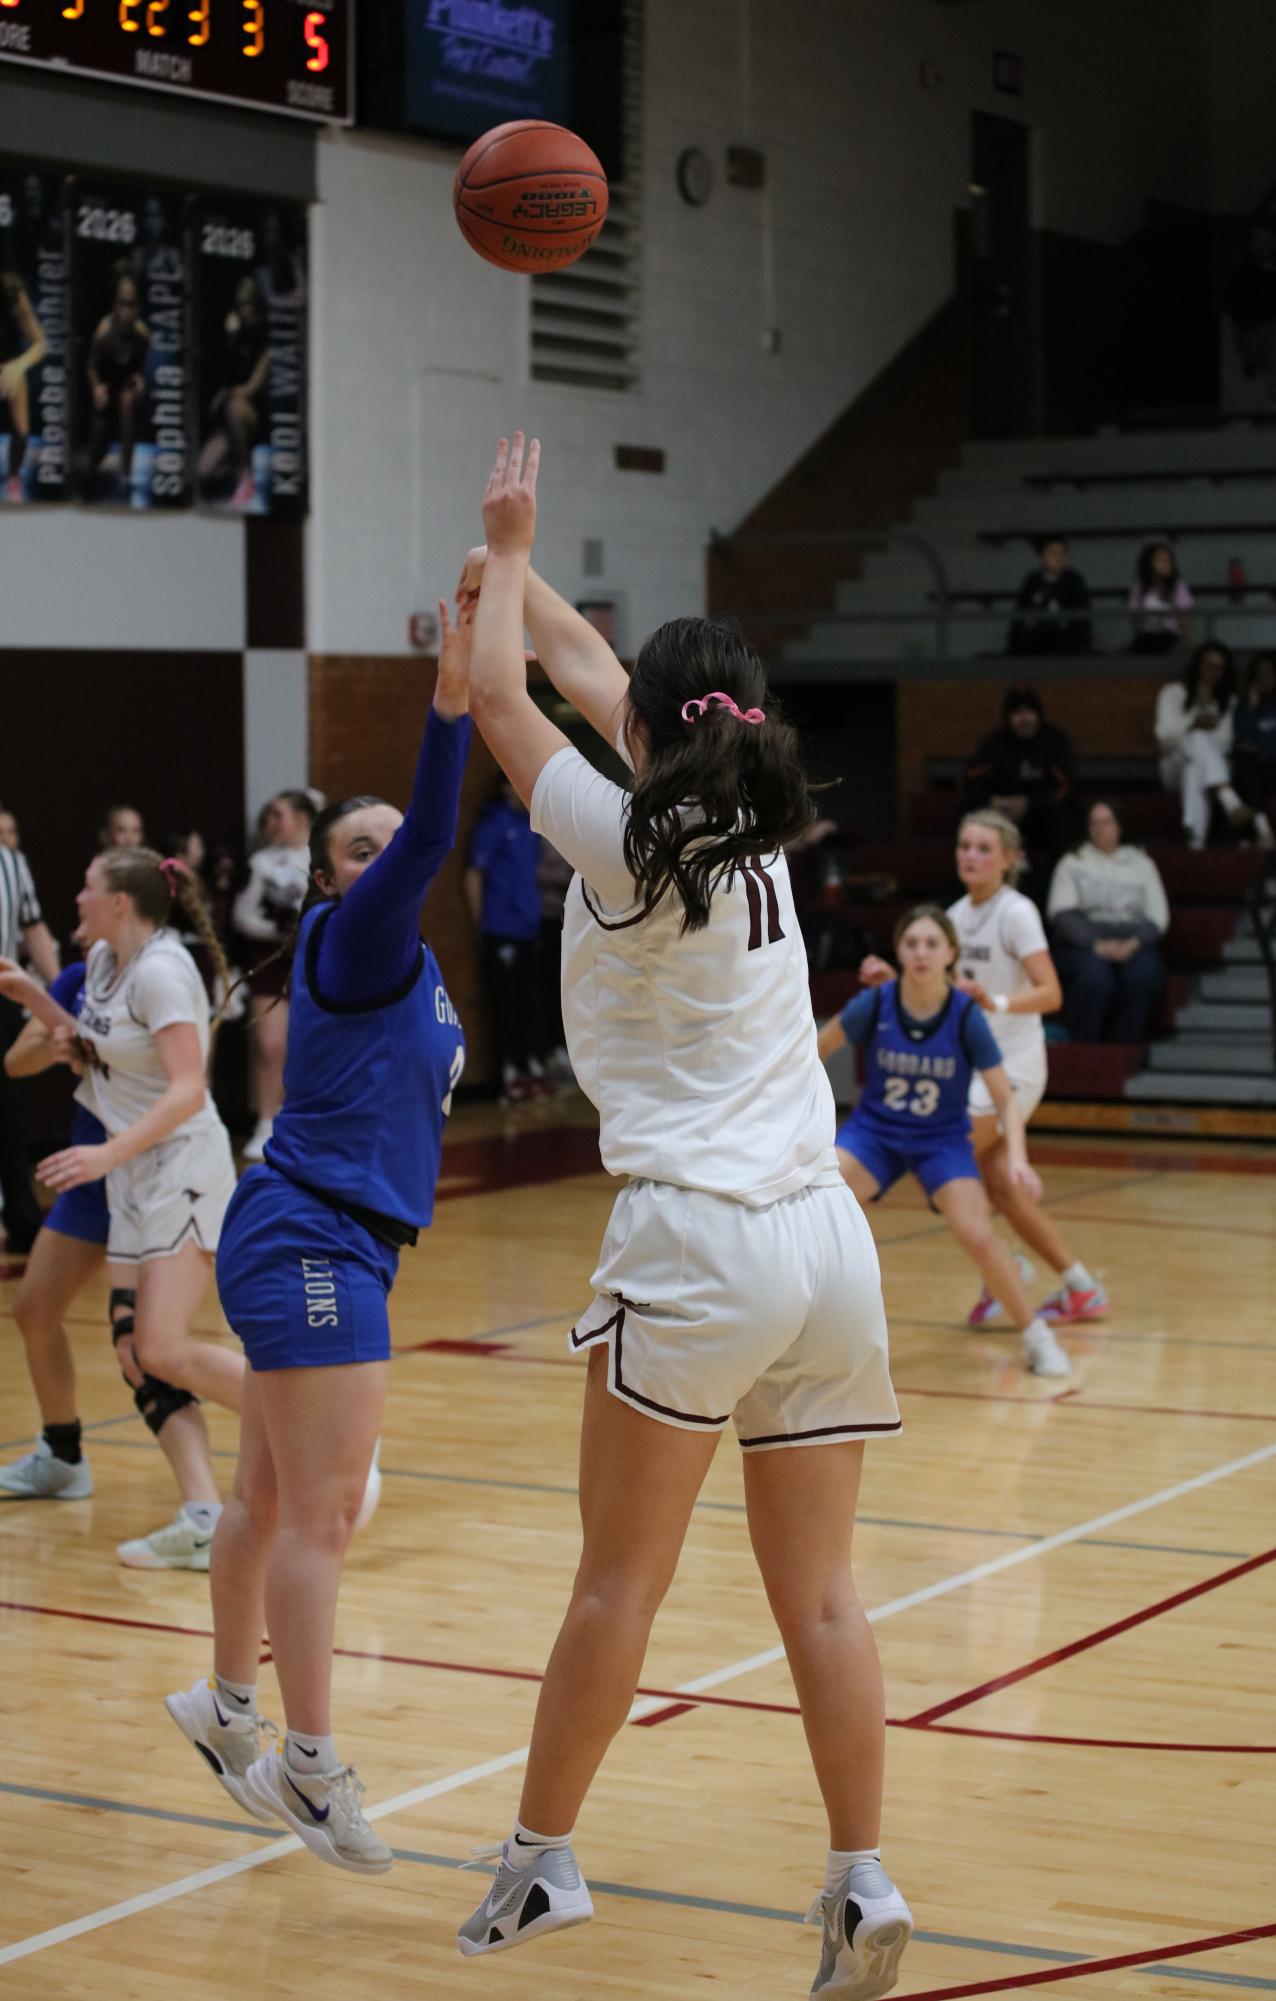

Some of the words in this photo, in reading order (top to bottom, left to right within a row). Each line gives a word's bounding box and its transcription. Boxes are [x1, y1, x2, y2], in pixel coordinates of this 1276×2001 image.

[0, 21, 31, 51] ORE
[243, 0, 264, 57] 3
[303, 11, 328, 72] 5
[135, 48, 192, 82] MATCH
[78, 206, 136, 244] 2026
[512, 201, 597, 219] LEGACY
[737, 853, 786, 952] 11
[882, 1076, 941, 1117] 23
[301, 1258, 338, 1328] LIONS
